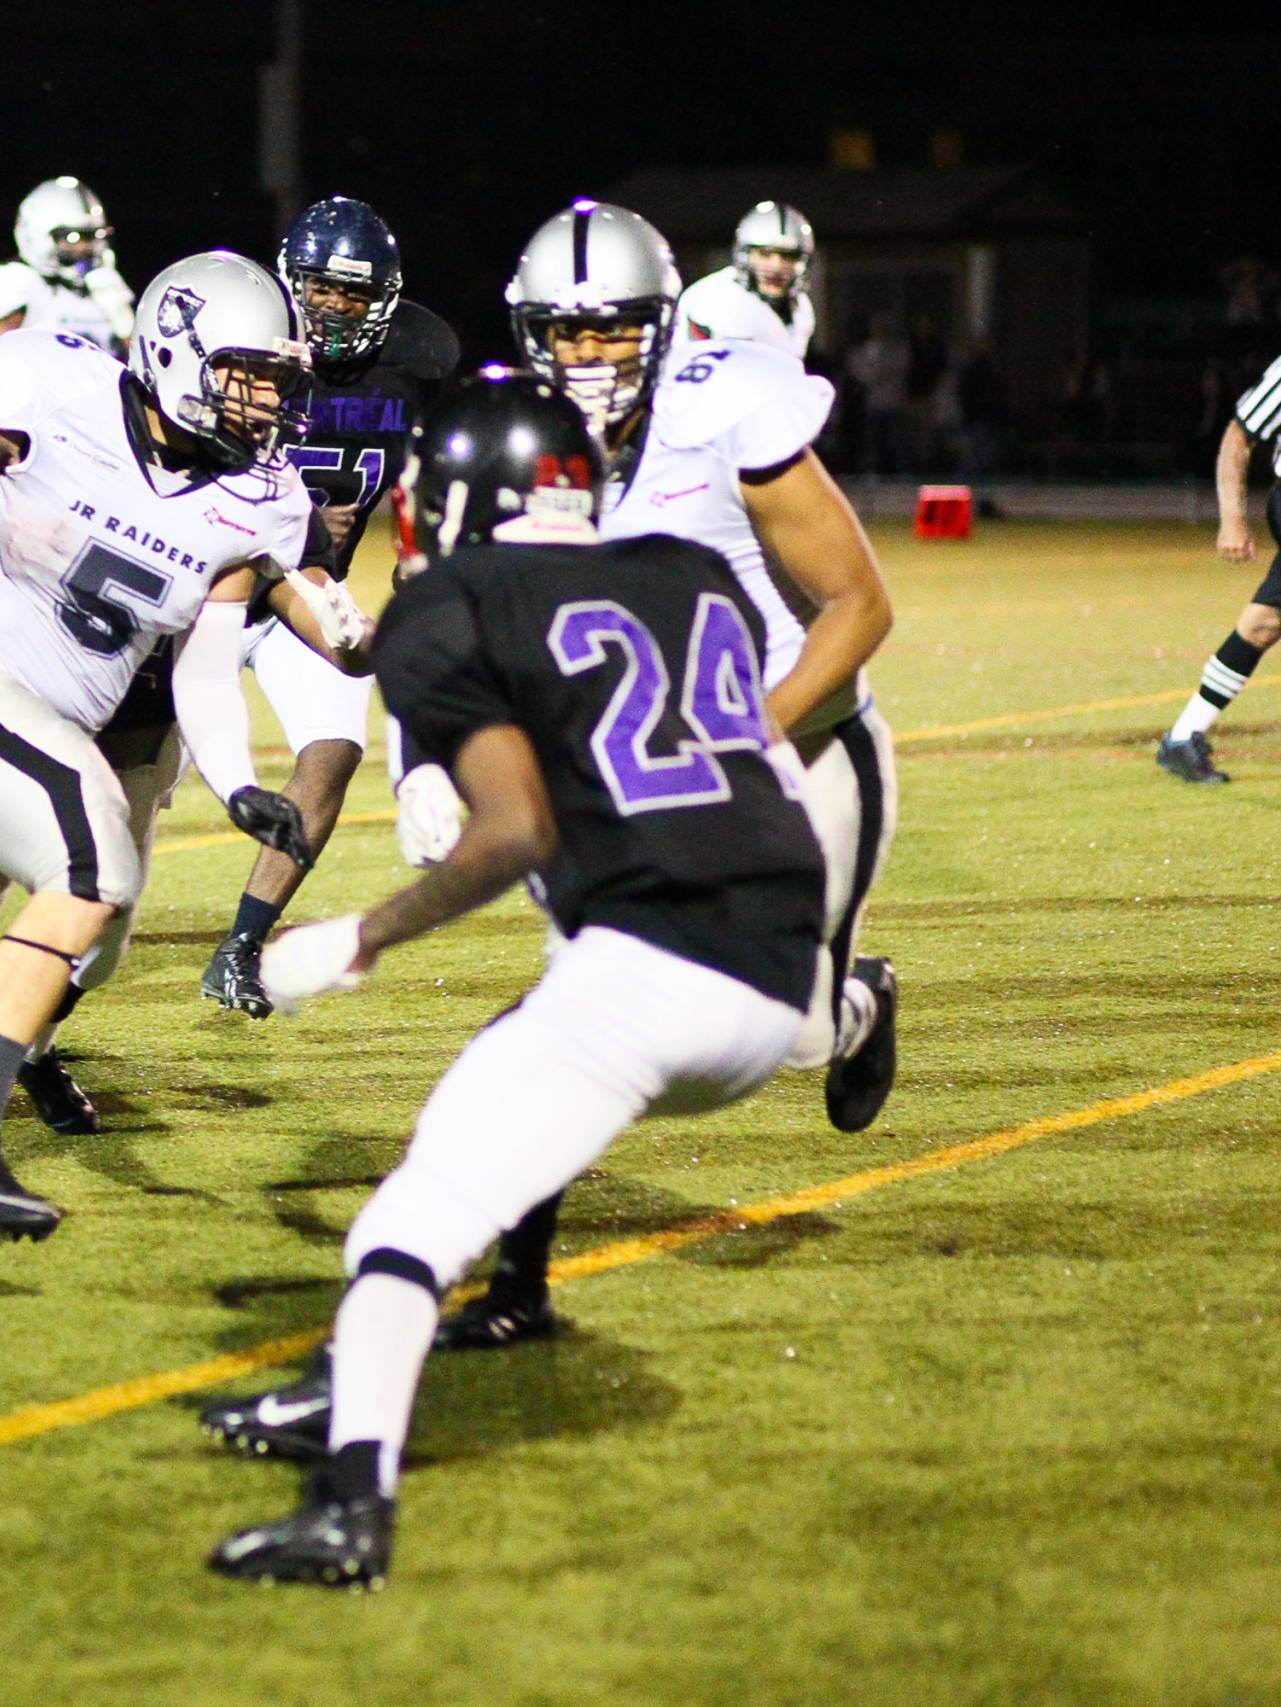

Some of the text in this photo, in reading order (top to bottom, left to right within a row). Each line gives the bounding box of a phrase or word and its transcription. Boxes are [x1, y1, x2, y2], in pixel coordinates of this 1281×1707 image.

[54, 535, 174, 660] 5
[69, 500, 96, 520] JR
[105, 516, 208, 574] RAIDERS
[546, 592, 769, 816] 24
